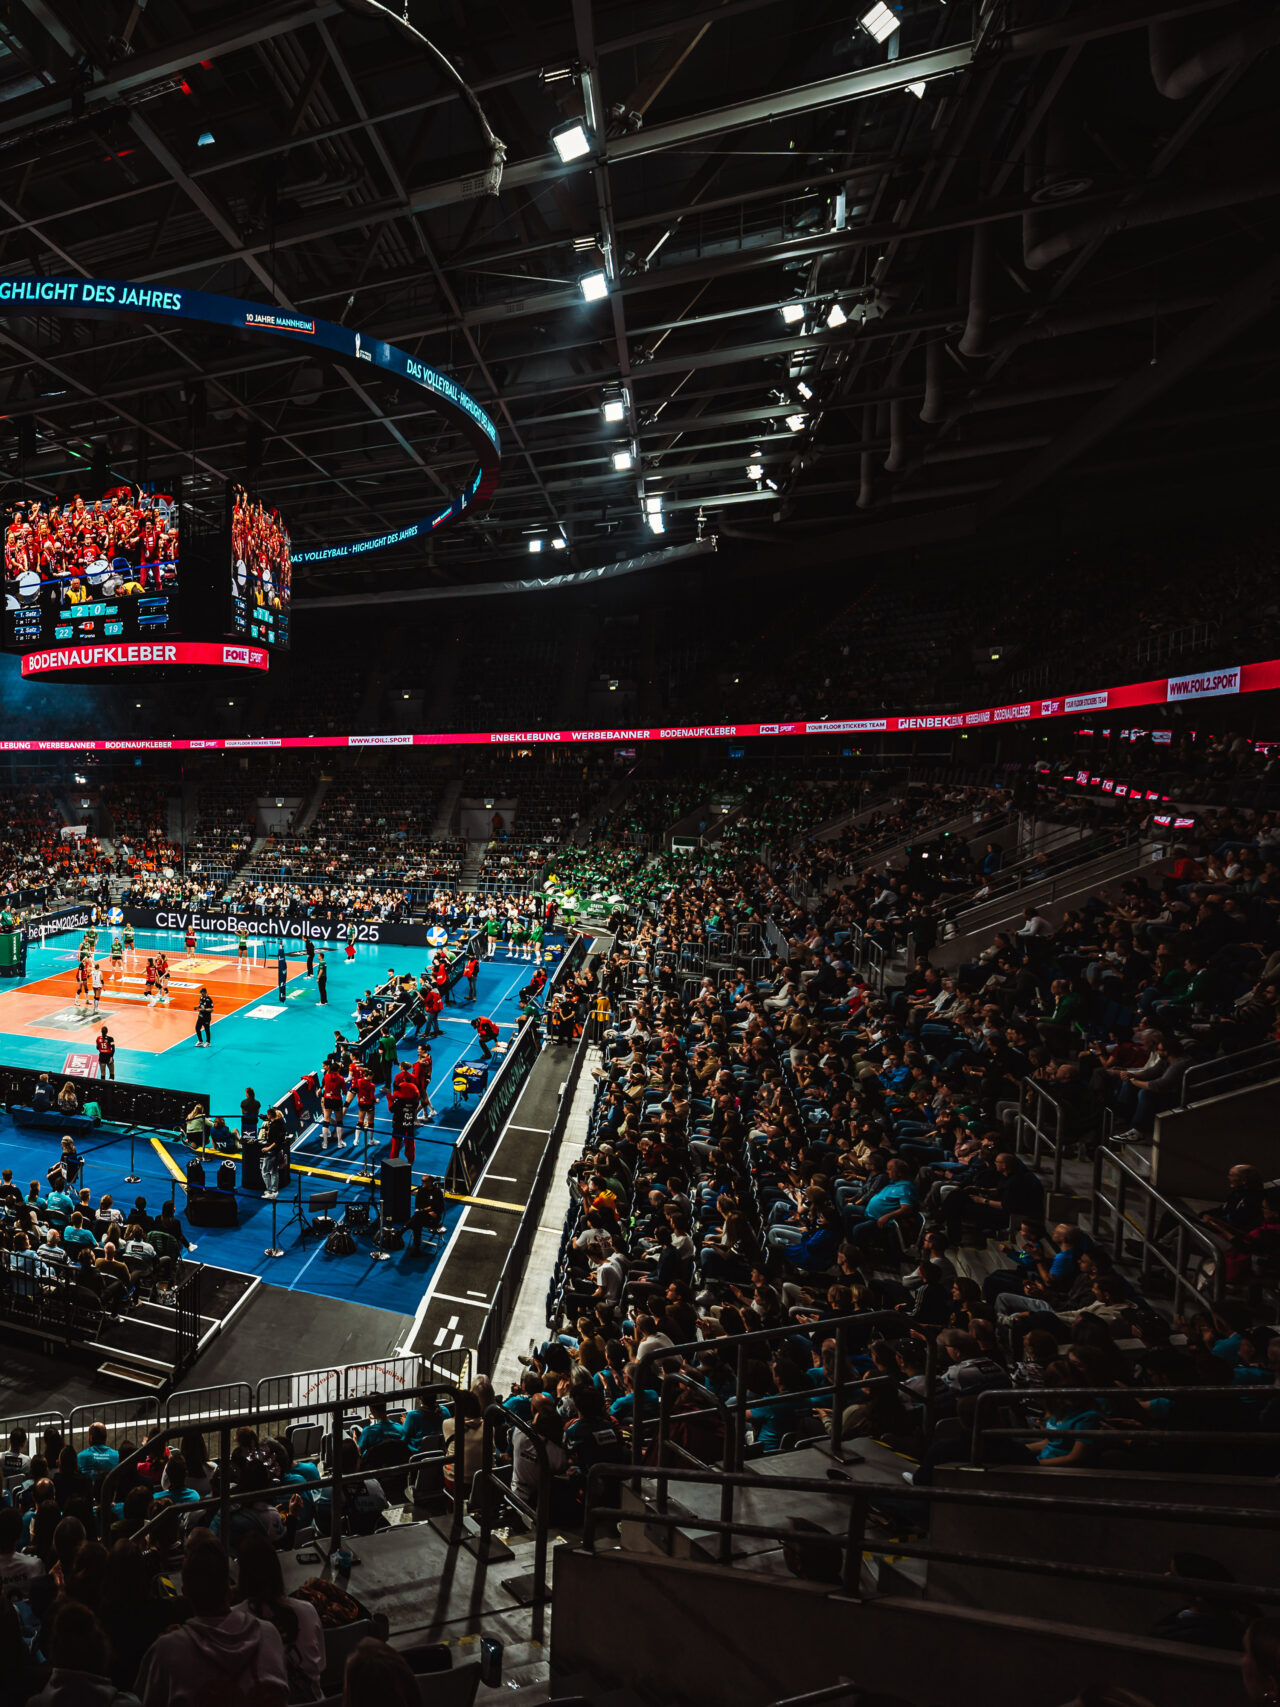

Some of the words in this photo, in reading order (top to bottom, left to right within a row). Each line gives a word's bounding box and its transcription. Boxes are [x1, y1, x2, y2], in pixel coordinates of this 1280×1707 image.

[82, 284, 116, 303] DES
[118, 287, 182, 311] JAHRES
[245, 313, 254, 322] 10
[254, 314, 276, 325] JAHRE
[276, 317, 313, 331] MANNHEIM!
[406, 359, 422, 380] DAS
[422, 368, 458, 402] VOLLEYBALL
[460, 394, 482, 423] HIGHLIGHT
[304, 546, 349, 561] VOLLEYBALL
[352, 537, 387, 554] HIGHLIGHT
[387, 534, 399, 546] DES
[398, 525, 418, 541] JAHRES
[76, 606, 84, 617] 2
[94, 604, 101, 615] 0
[59, 629, 69, 637] 22
[108, 625, 119, 633] 19
[29, 646, 177, 670] BODENAUFKLEBER
[1169, 673, 1239, 696] WWW.FOIL2.SPORT
[105, 741, 172, 749] BODENAUFKLEBER
[490, 733, 561, 742] ENBEKLEBUNG
[572, 730, 650, 740] WERBEBANNER
[660, 727, 737, 738] BODENAUFKLEBER
[155, 911, 187, 929] CEV
[192, 914, 332, 940] EuroBeachVolley
[336, 923, 380, 942] 2025
